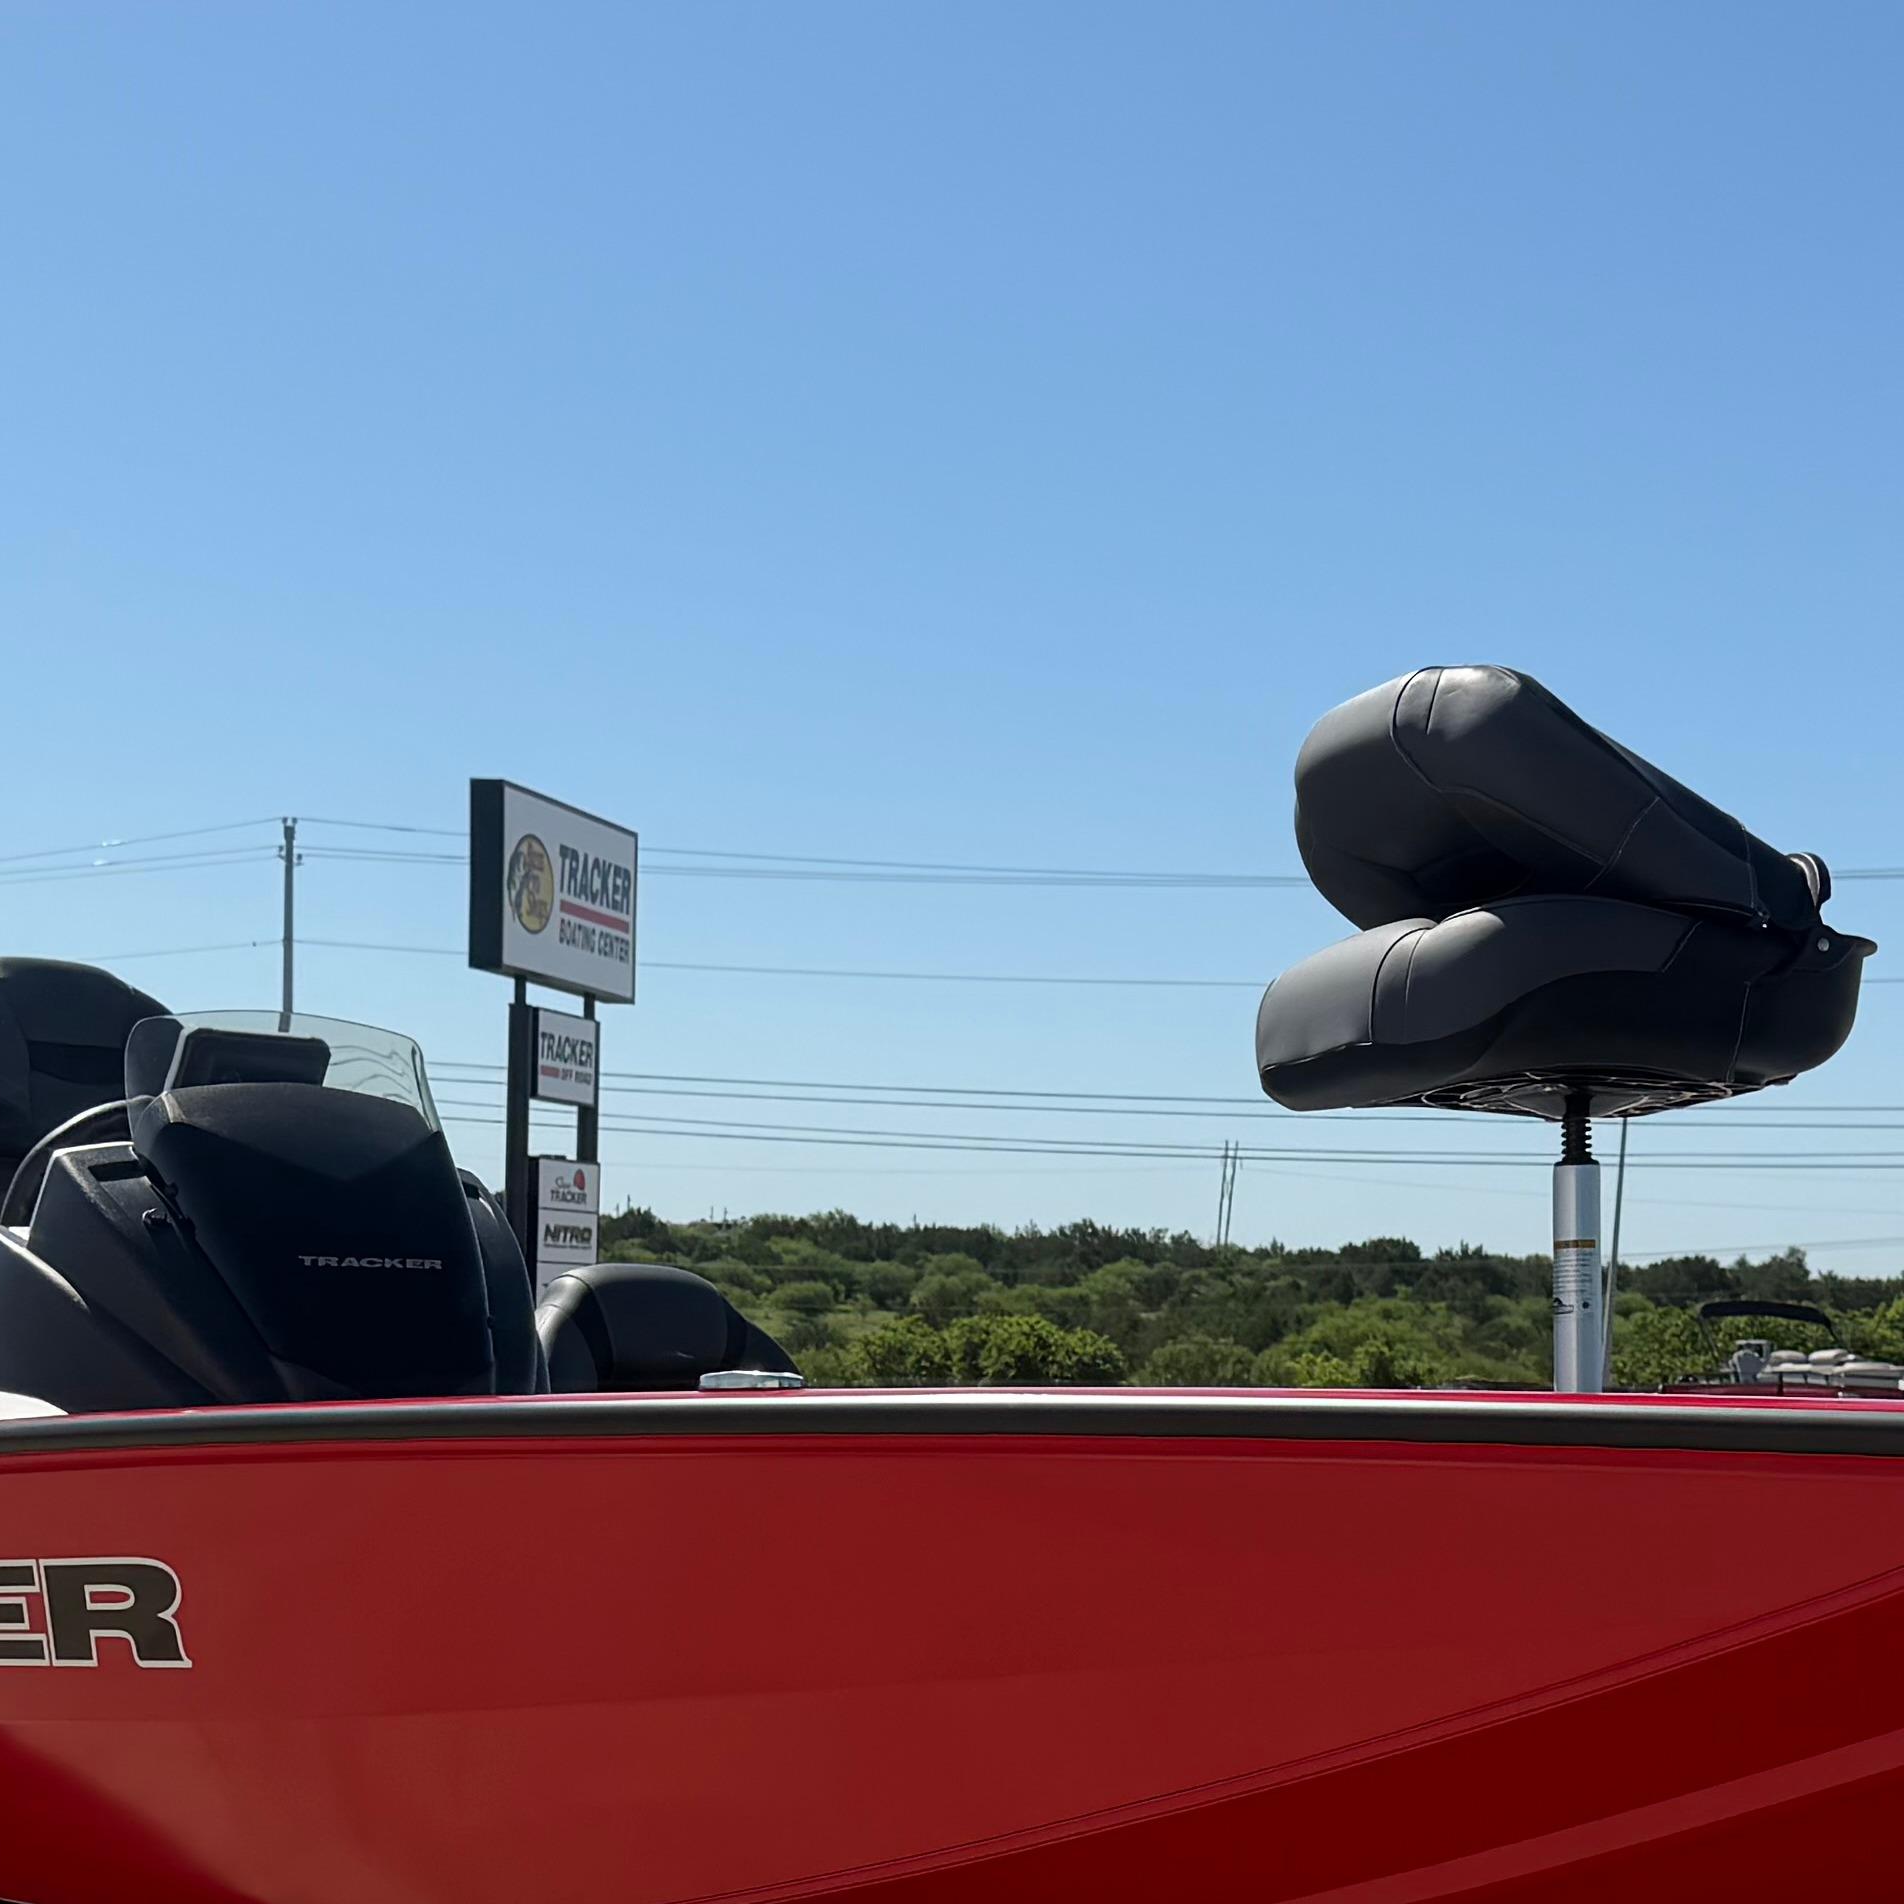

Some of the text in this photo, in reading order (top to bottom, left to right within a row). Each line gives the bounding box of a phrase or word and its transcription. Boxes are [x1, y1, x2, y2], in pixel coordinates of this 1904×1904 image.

[559, 844, 632, 916] TRACKER
[559, 918, 631, 964] BOATING CENTER
[540, 1031, 594, 1068] TRACKER
[549, 1188, 588, 1205] TRACKER
[542, 1223, 593, 1246] NITRO
[297, 1254, 443, 1270] TRACKER
